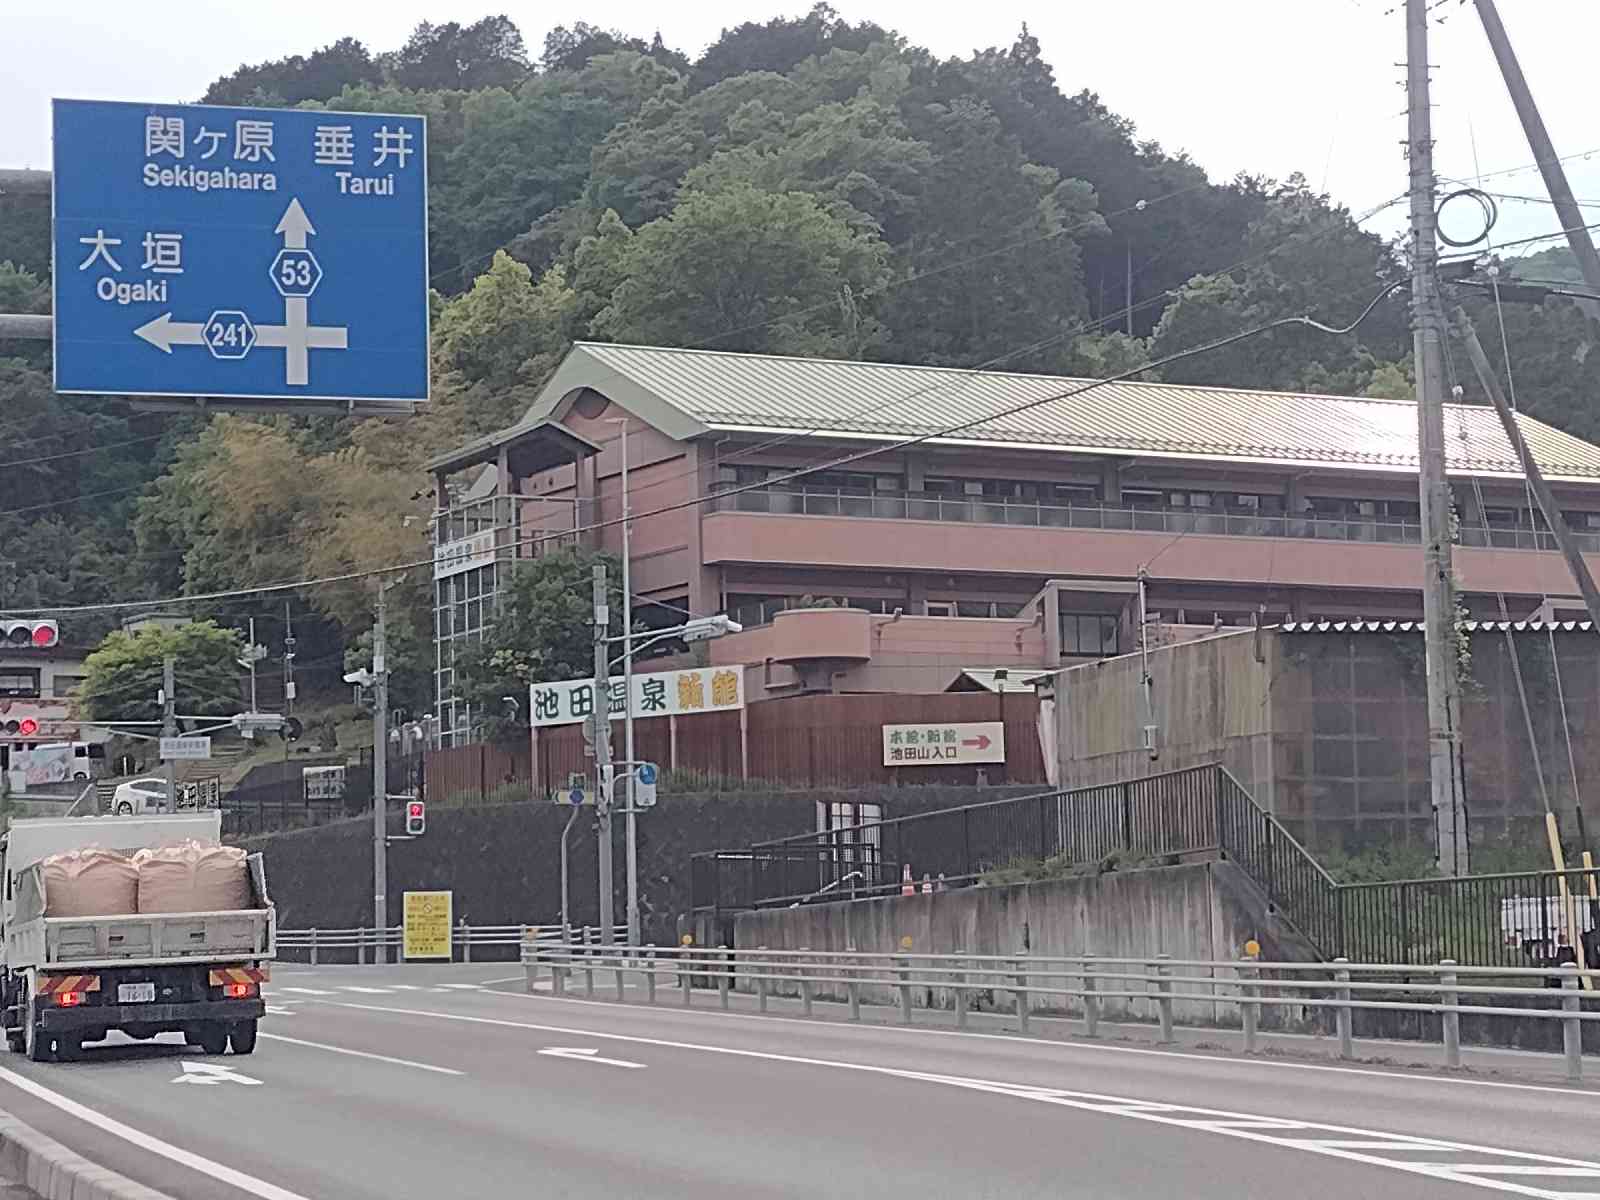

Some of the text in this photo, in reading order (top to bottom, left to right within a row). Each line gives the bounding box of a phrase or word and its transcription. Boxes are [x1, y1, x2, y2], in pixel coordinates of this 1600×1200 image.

[314, 125, 413, 168] 垂井
[143, 163, 276, 192] Sekigahara
[336, 171, 394, 195] Tarui
[79, 229, 184, 274] 大垣
[281, 259, 312, 286] 53
[97, 277, 167, 305] Ogaki
[211, 322, 248, 347] 241
[890, 745, 958, 760] 池田山入口
